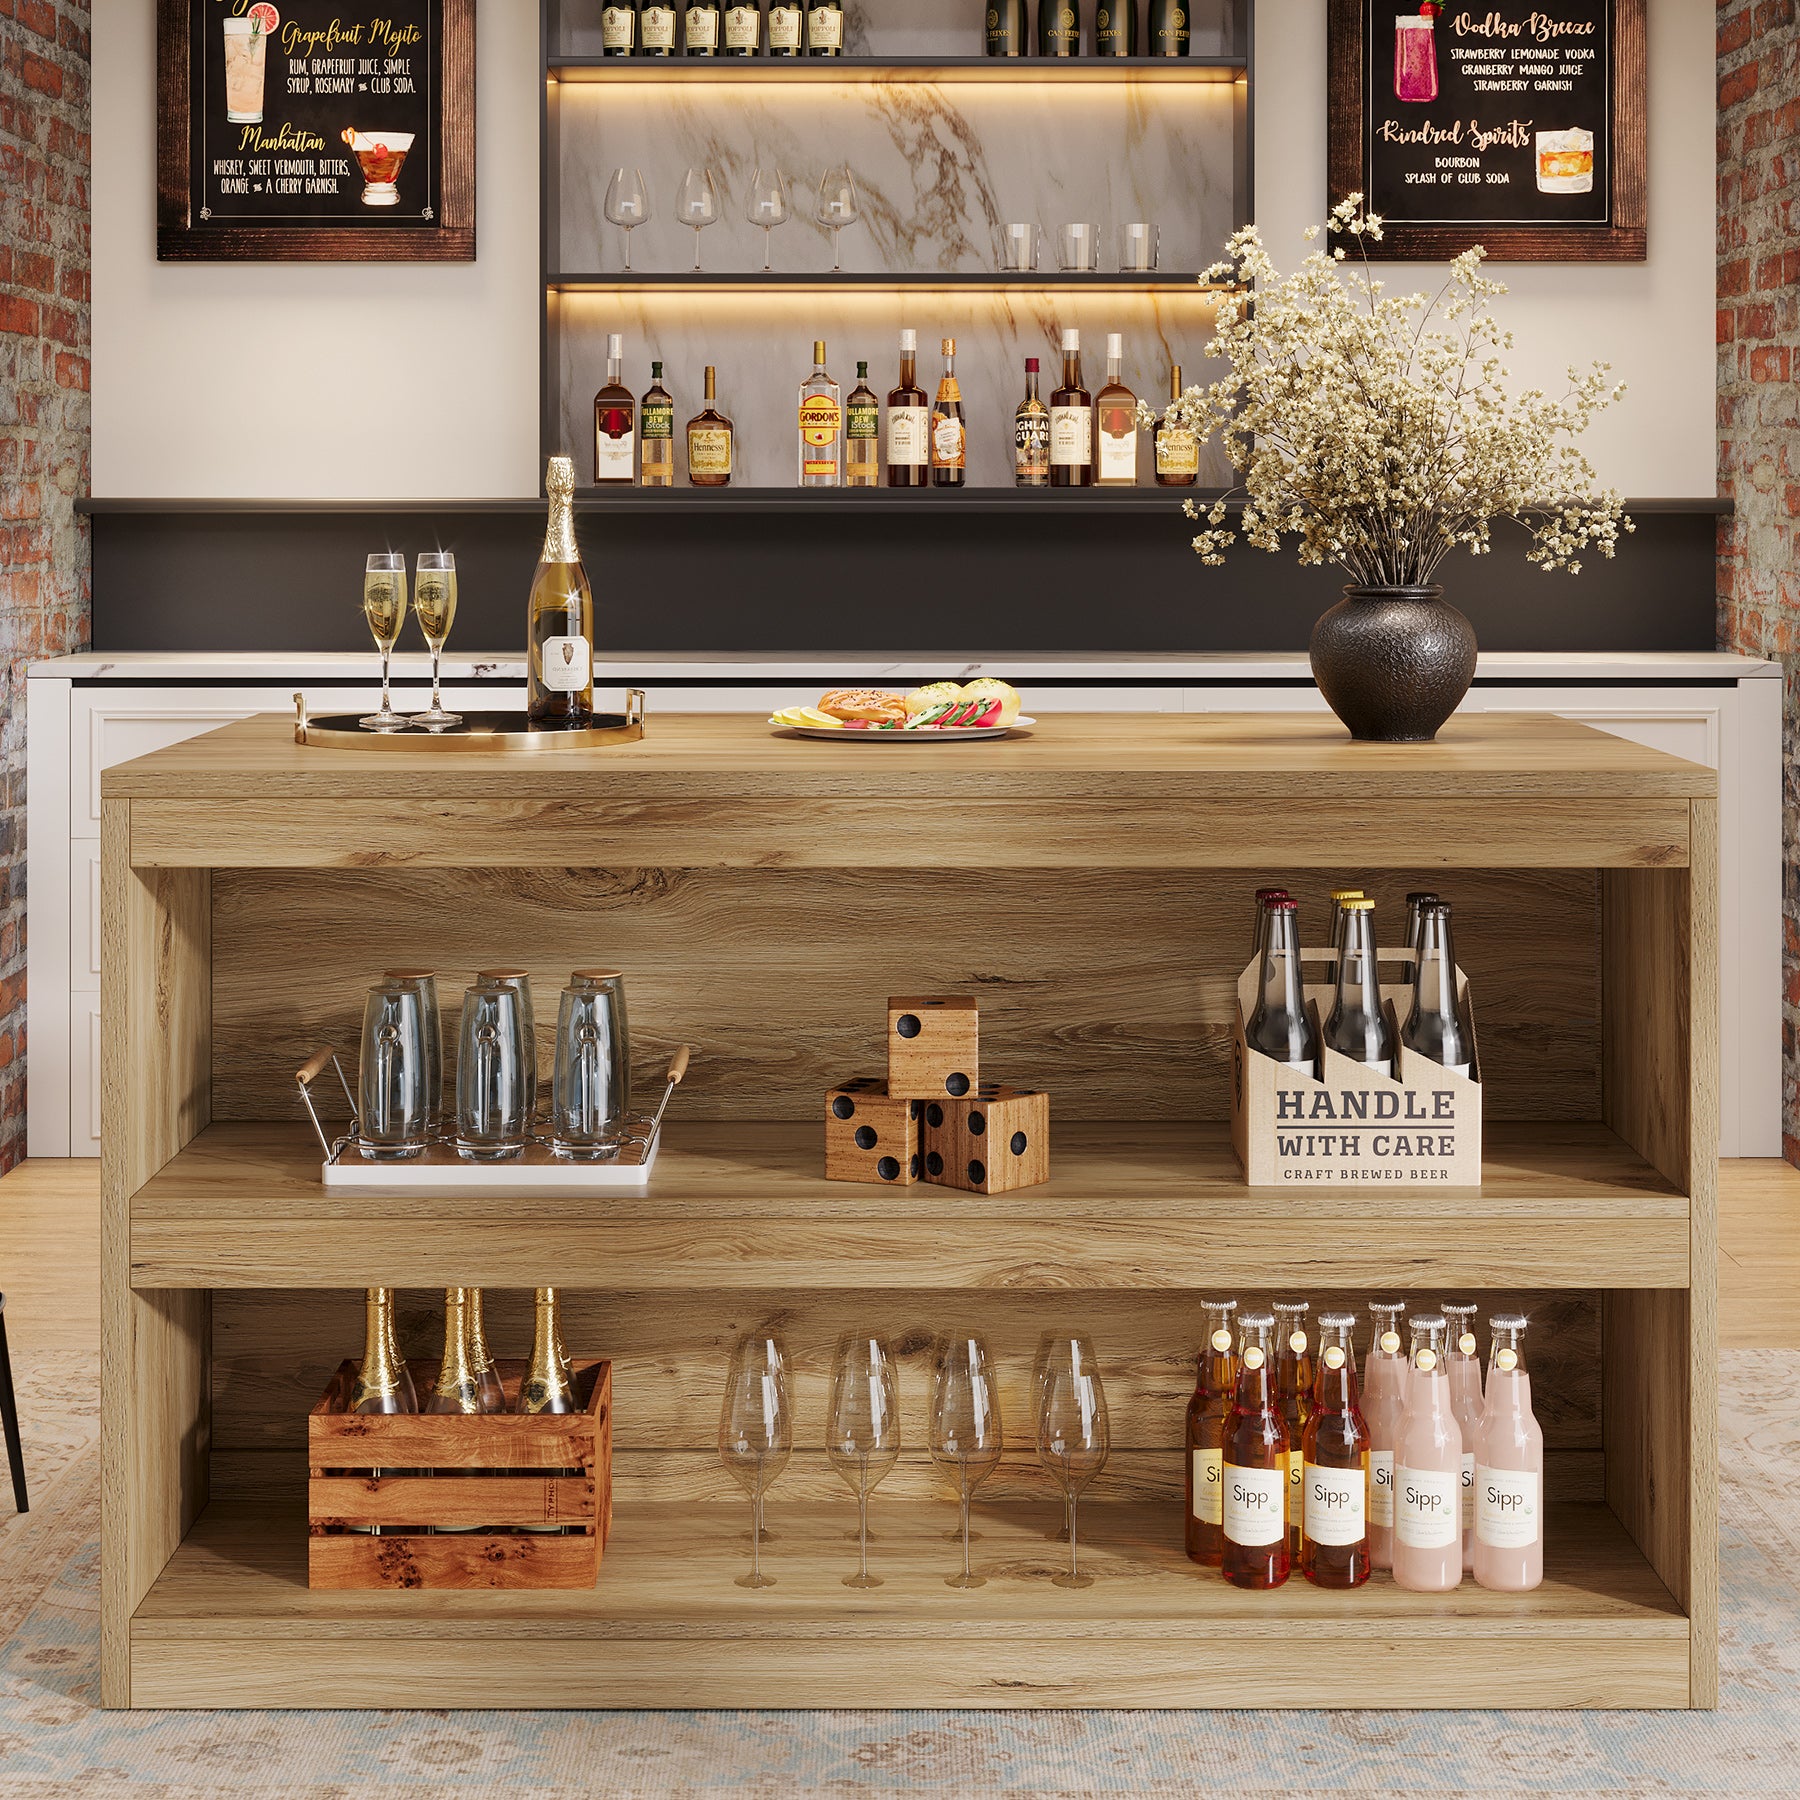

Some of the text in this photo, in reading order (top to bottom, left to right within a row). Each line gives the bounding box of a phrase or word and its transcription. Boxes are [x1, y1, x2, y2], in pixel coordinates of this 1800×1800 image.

[1449, 11, 1595, 42] Vodka Breeze
[281, 17, 422, 57] Grapefruit Mojito
[1450, 48, 1596, 60] STRAWBERRY LEMONADE VODKA
[289, 59, 411, 76] RUM, GRAPEFRUIT JUICE, SIMPLE
[1461, 64, 1584, 76] CRANBERRY MANGO JUICE
[287, 78, 312, 95] SYRUP,
[315, 78, 354, 94] ROSEMARY
[371, 77, 391, 94] CLUB
[393, 77, 417, 94] SODA.
[1473, 80, 1573, 92] STRAWBERRY GARNISH
[237, 121, 326, 153] Manhattan
[1376, 119, 1534, 152] Kindred Spirits
[213, 159, 351, 176] WHISKEY, SWEET VERMOUTH, BITTERS,
[1434, 157, 1480, 169] BOURBON
[221, 178, 250, 194] ORANGE
[265, 178, 273, 194] A
[275, 178, 303, 194] CHERRY
[305, 178, 339, 194] GARNISH.
[1405, 173, 1510, 184] SPLASH OF CLUB SODA
[646, 421, 671, 429] iStock
[851, 421, 876, 429] iStock
[693, 442, 724, 453] Hennessy
[1276, 1090, 1455, 1120] HANDLE
[1276, 1135, 1455, 1157] WITH CARE
[1283, 1169, 1449, 1180] CRAFT BREWED BEER
[1233, 1484, 1269, 1510] Sipp
[1314, 1484, 1350, 1510] Sipp
[1405, 1486, 1442, 1512] Sipp
[1486, 1486, 1523, 1512] Sipp
